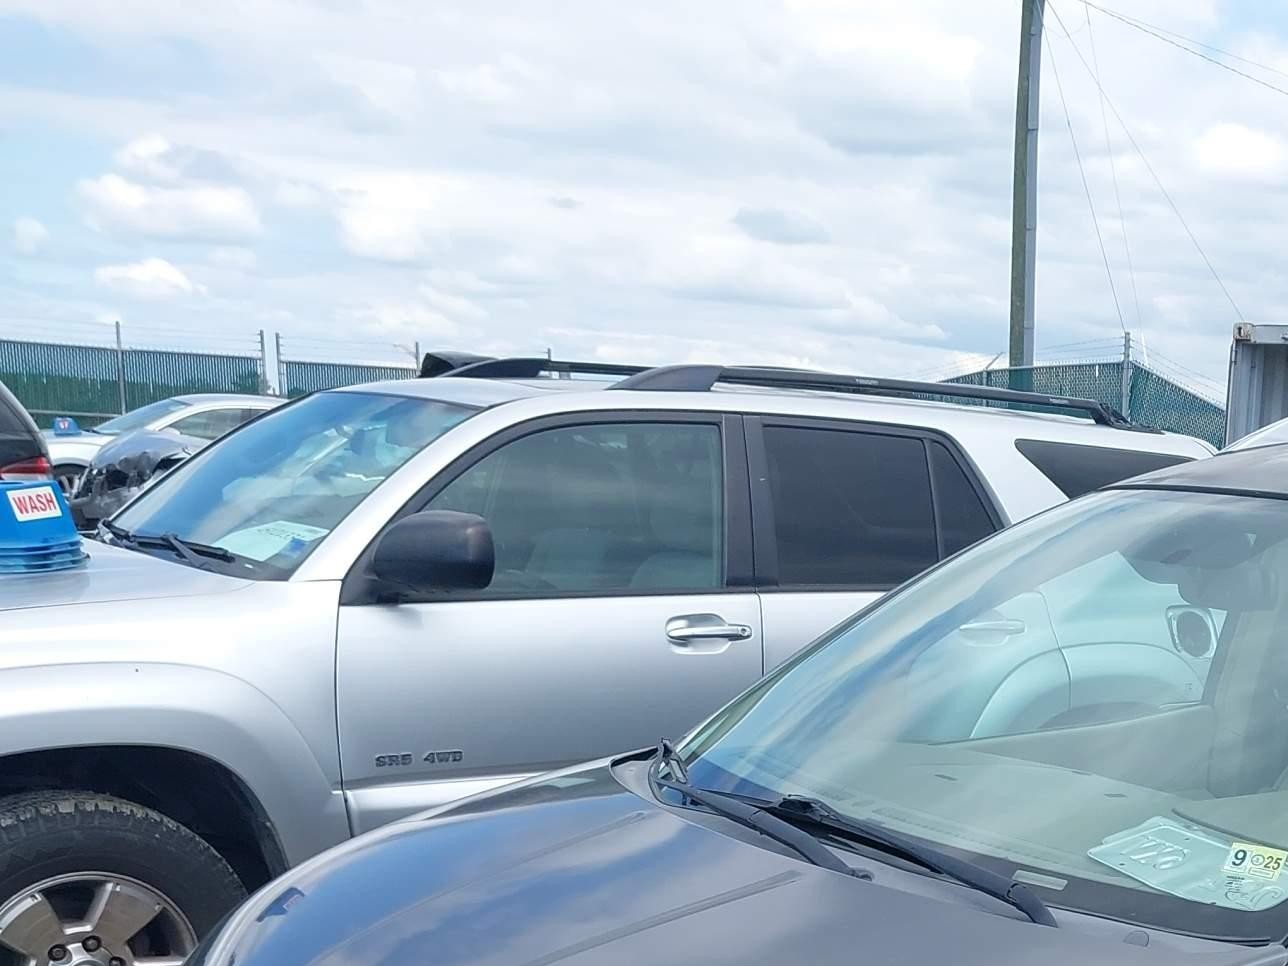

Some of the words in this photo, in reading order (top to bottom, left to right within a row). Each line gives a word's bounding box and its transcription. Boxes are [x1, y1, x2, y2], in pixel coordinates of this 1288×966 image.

[12, 493, 57, 515] WASH
[375, 753, 412, 768] SR5
[423, 750, 463, 764] 4WD
[1231, 849, 1248, 867] 9
[1263, 855, 1283, 871] 25
